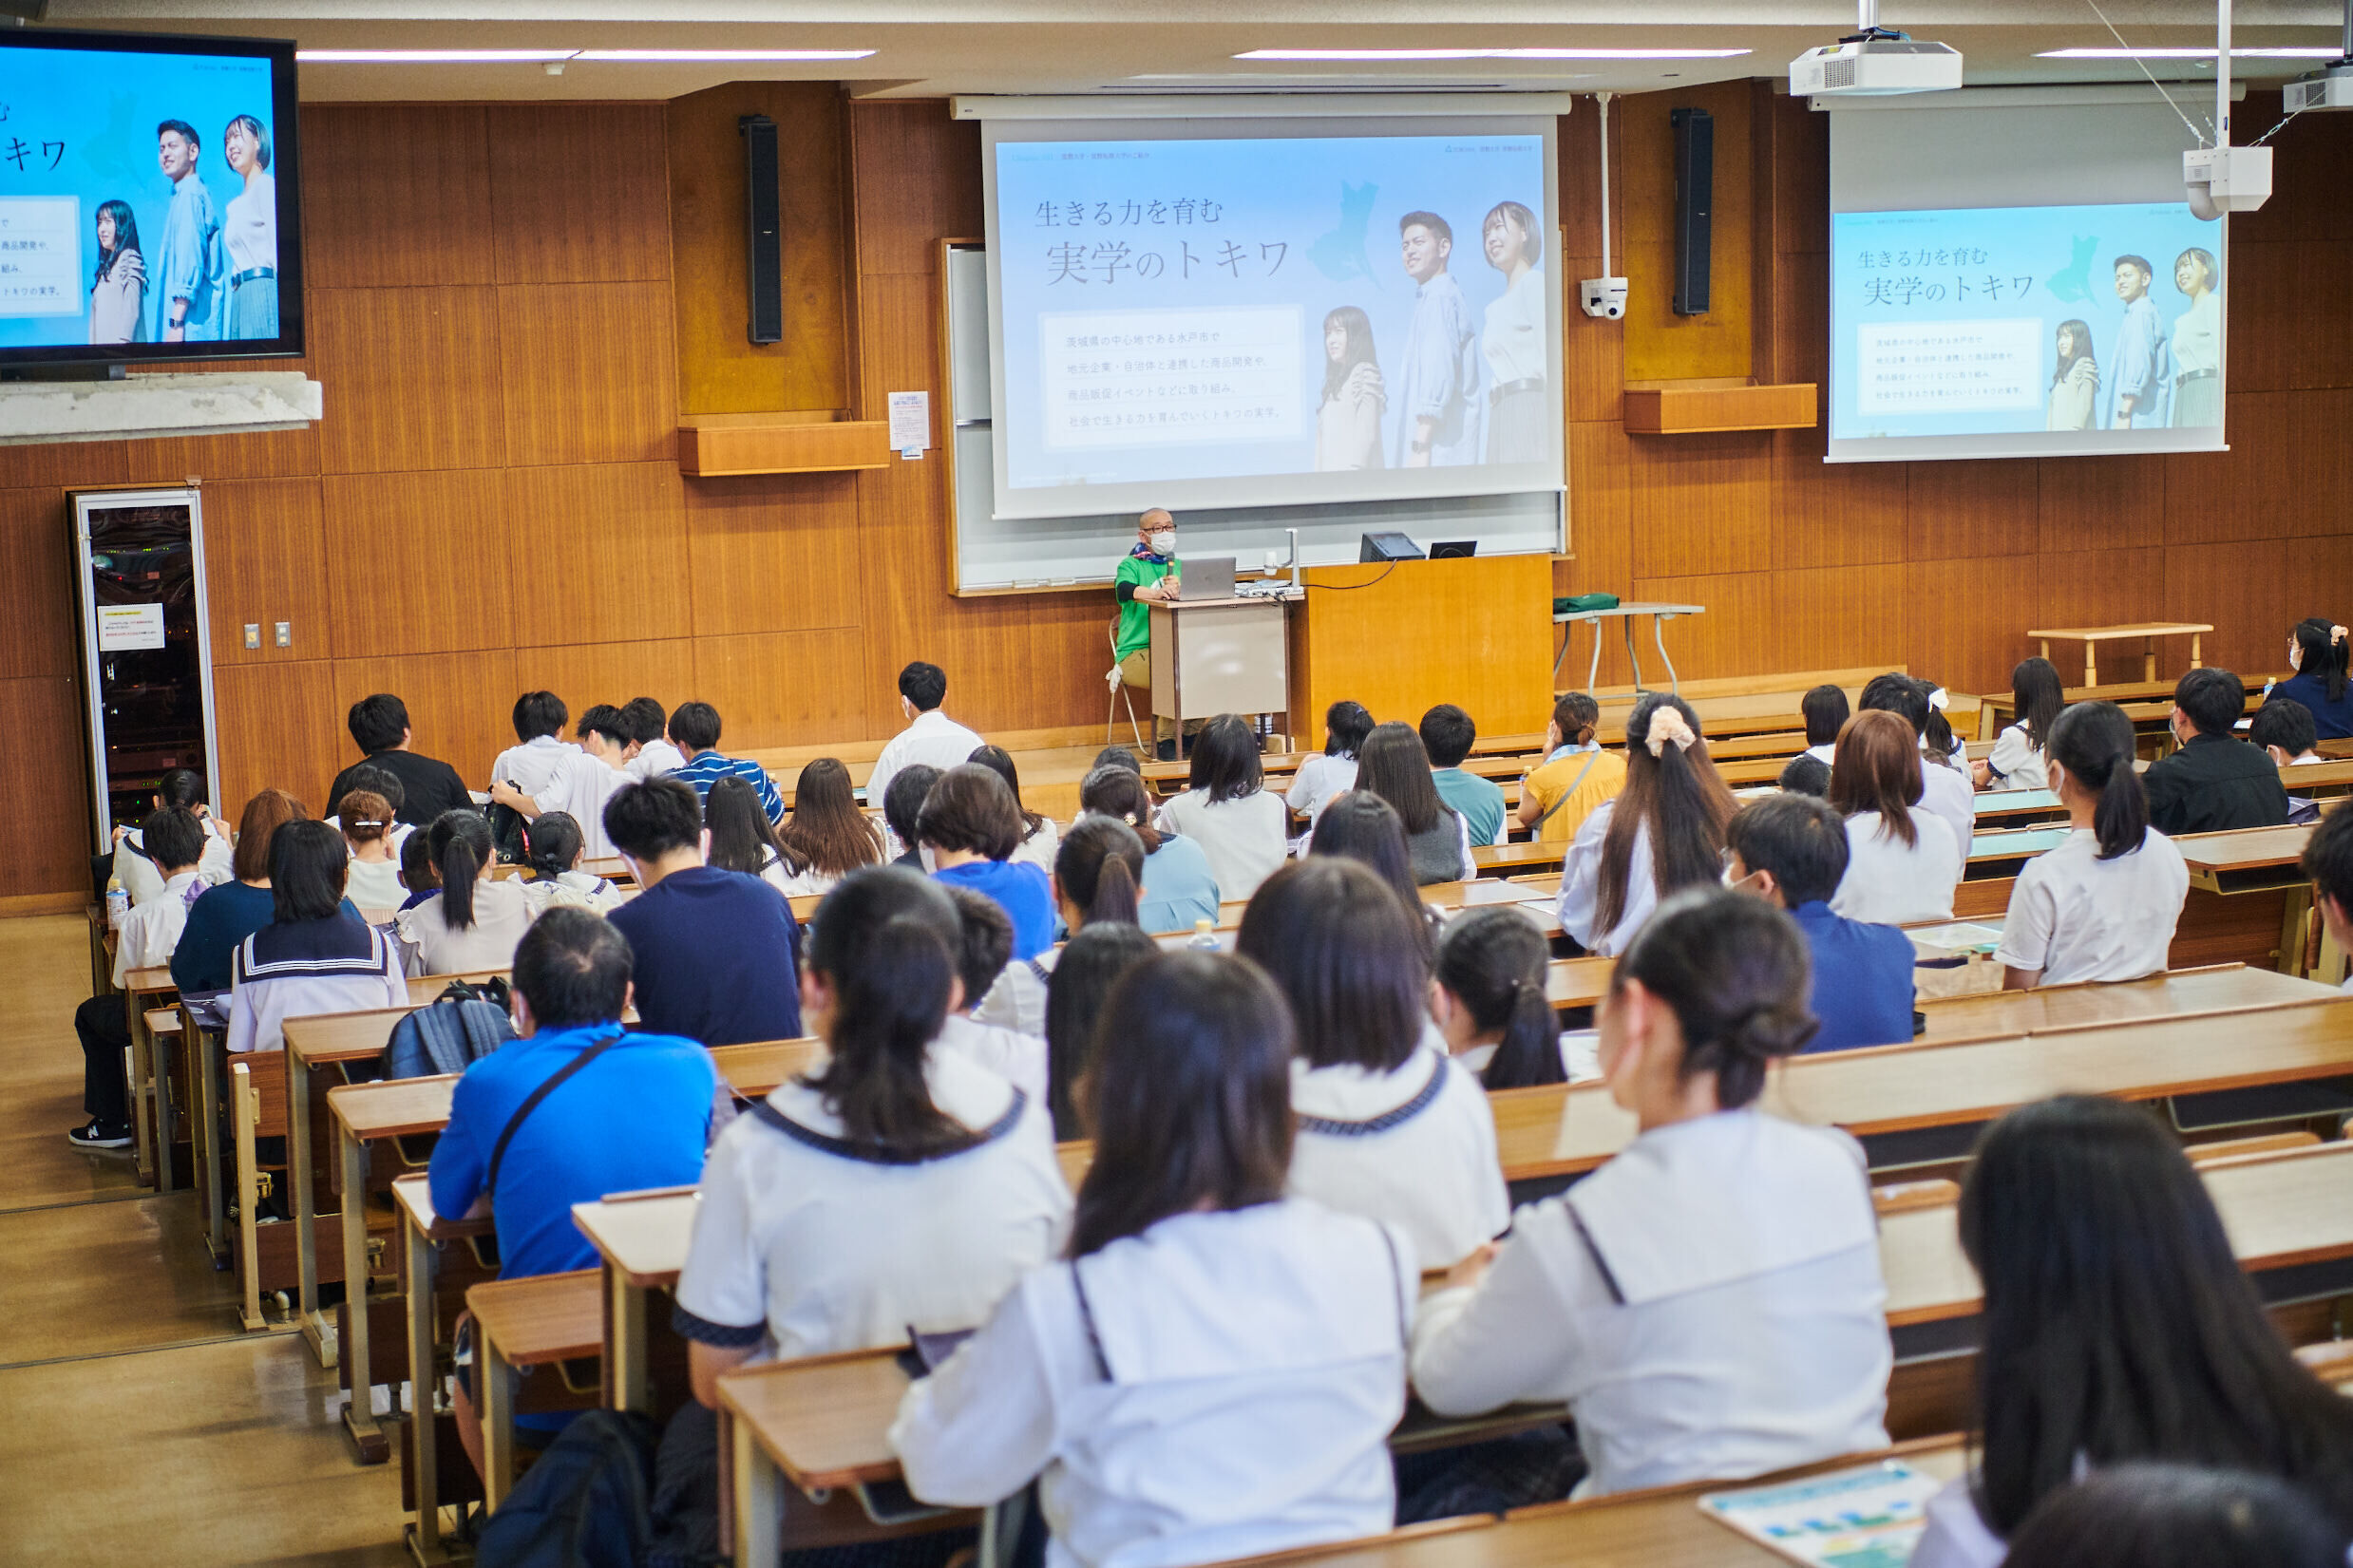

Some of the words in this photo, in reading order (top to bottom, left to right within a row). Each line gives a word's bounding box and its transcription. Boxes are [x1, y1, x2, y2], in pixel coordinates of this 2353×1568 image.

[6, 137, 65, 171] キワ
[1034, 198, 1223, 228] 生きる力を育む
[1047, 240, 1288, 286] 実学のトキワ
[1858, 247, 1988, 269] 生きる力を育む
[1864, 275, 2033, 307] 実学のトキワ
